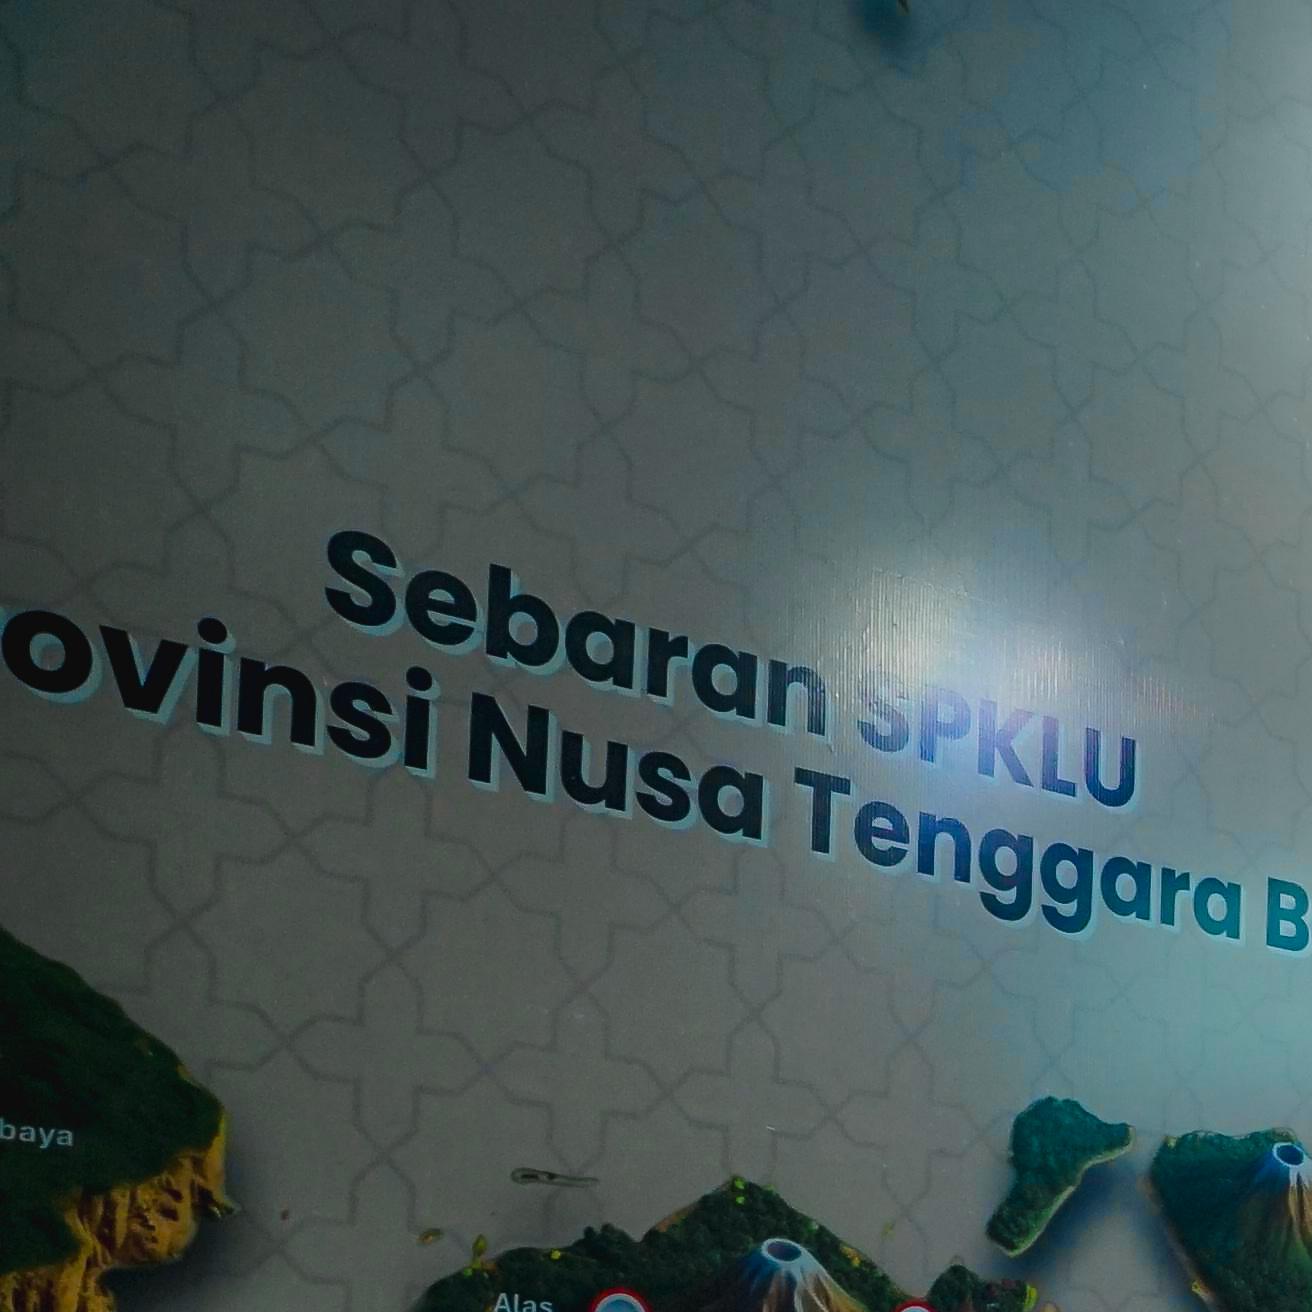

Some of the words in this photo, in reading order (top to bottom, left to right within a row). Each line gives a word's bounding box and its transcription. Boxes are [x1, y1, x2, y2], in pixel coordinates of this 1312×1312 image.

[324, 529, 828, 738] Sebaran
[856, 672, 1137, 807] SPKLU
[467, 691, 766, 842] Nusa
[795, 766, 1243, 935] Tenggara
